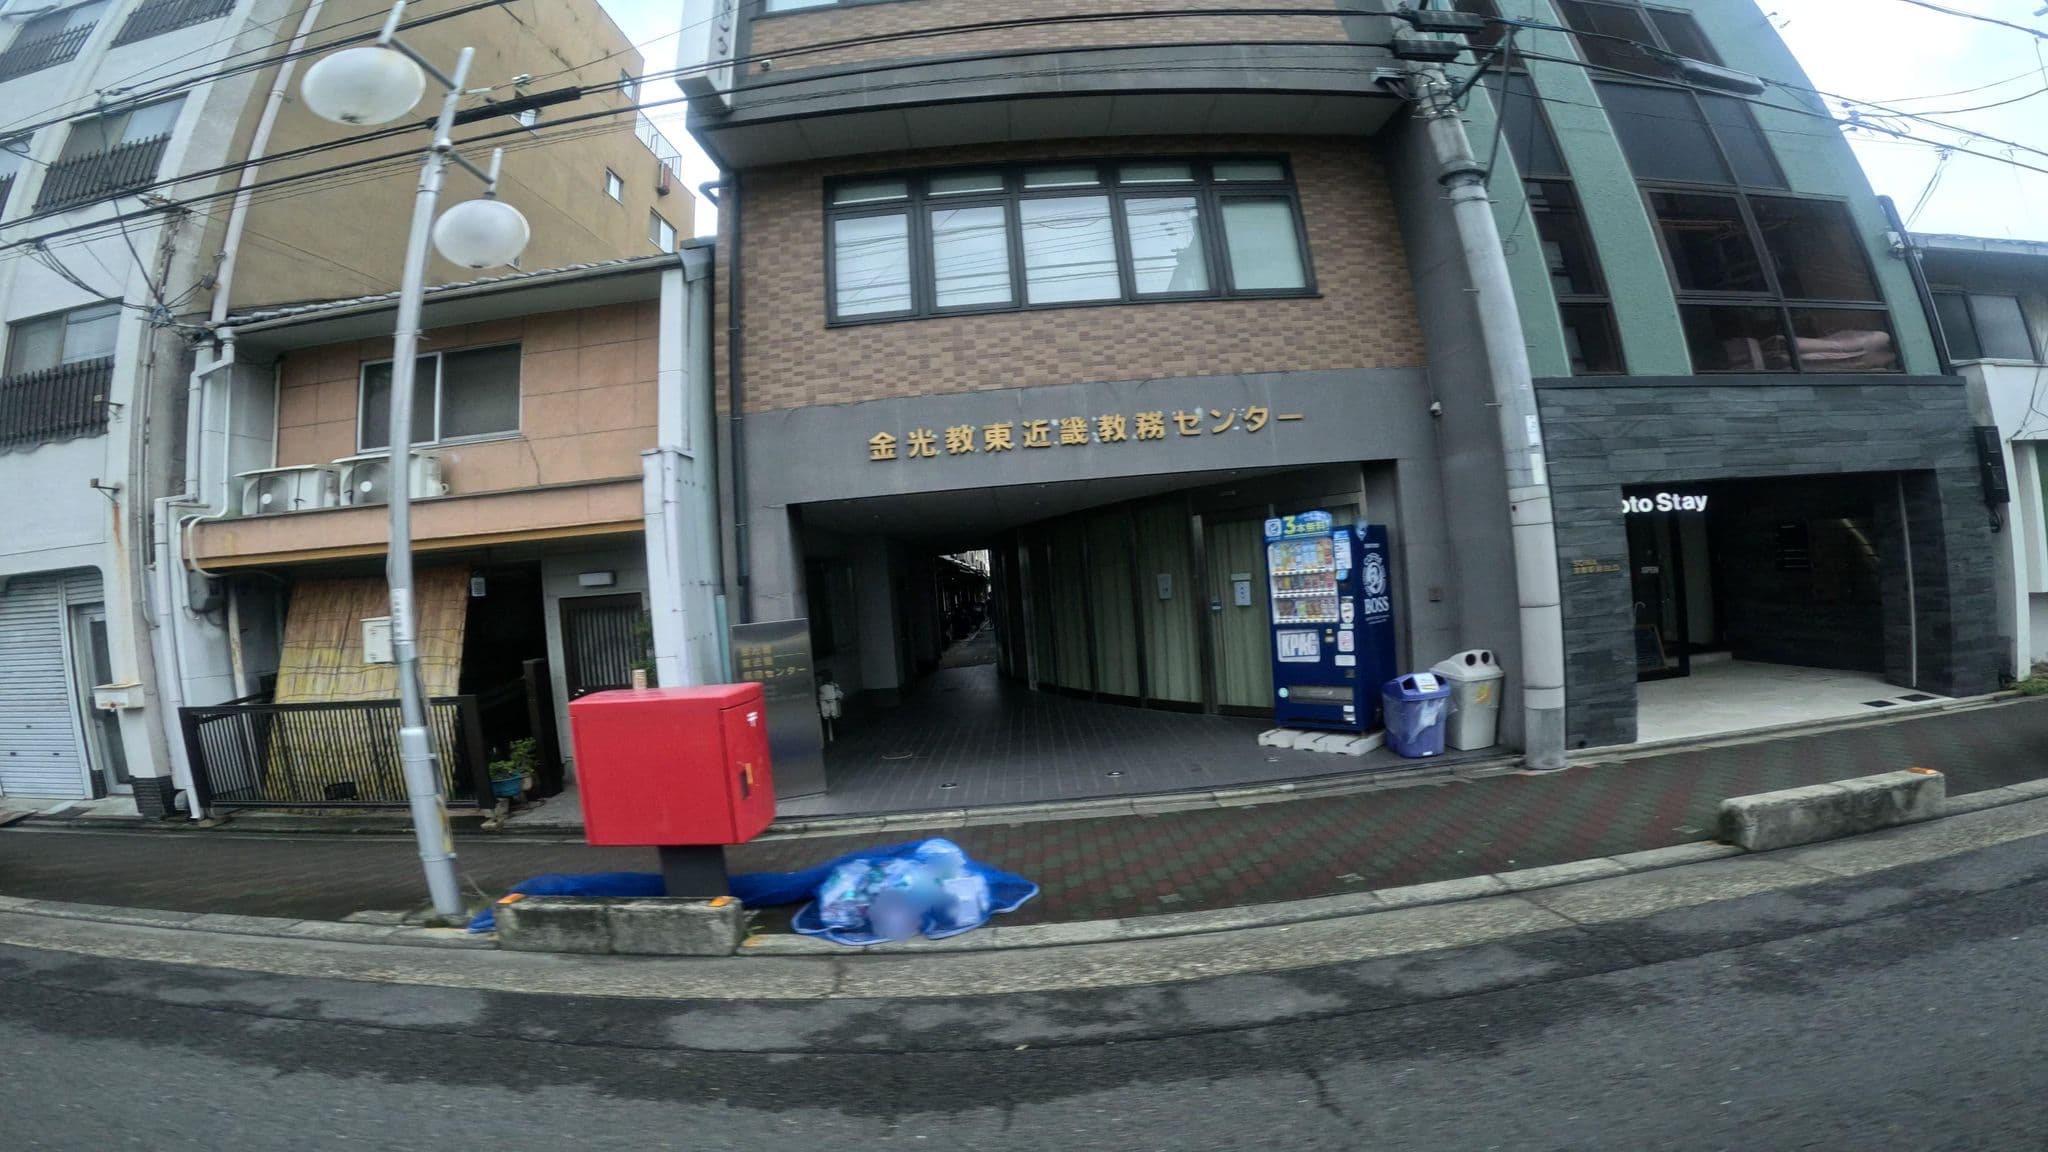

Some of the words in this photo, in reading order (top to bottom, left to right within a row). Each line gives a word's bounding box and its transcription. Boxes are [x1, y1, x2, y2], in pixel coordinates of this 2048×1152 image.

[868, 405, 1305, 461] 金光教東近畿教務センター
[1656, 492, 1708, 512] Stay
[1364, 596, 1390, 615] BOSS
